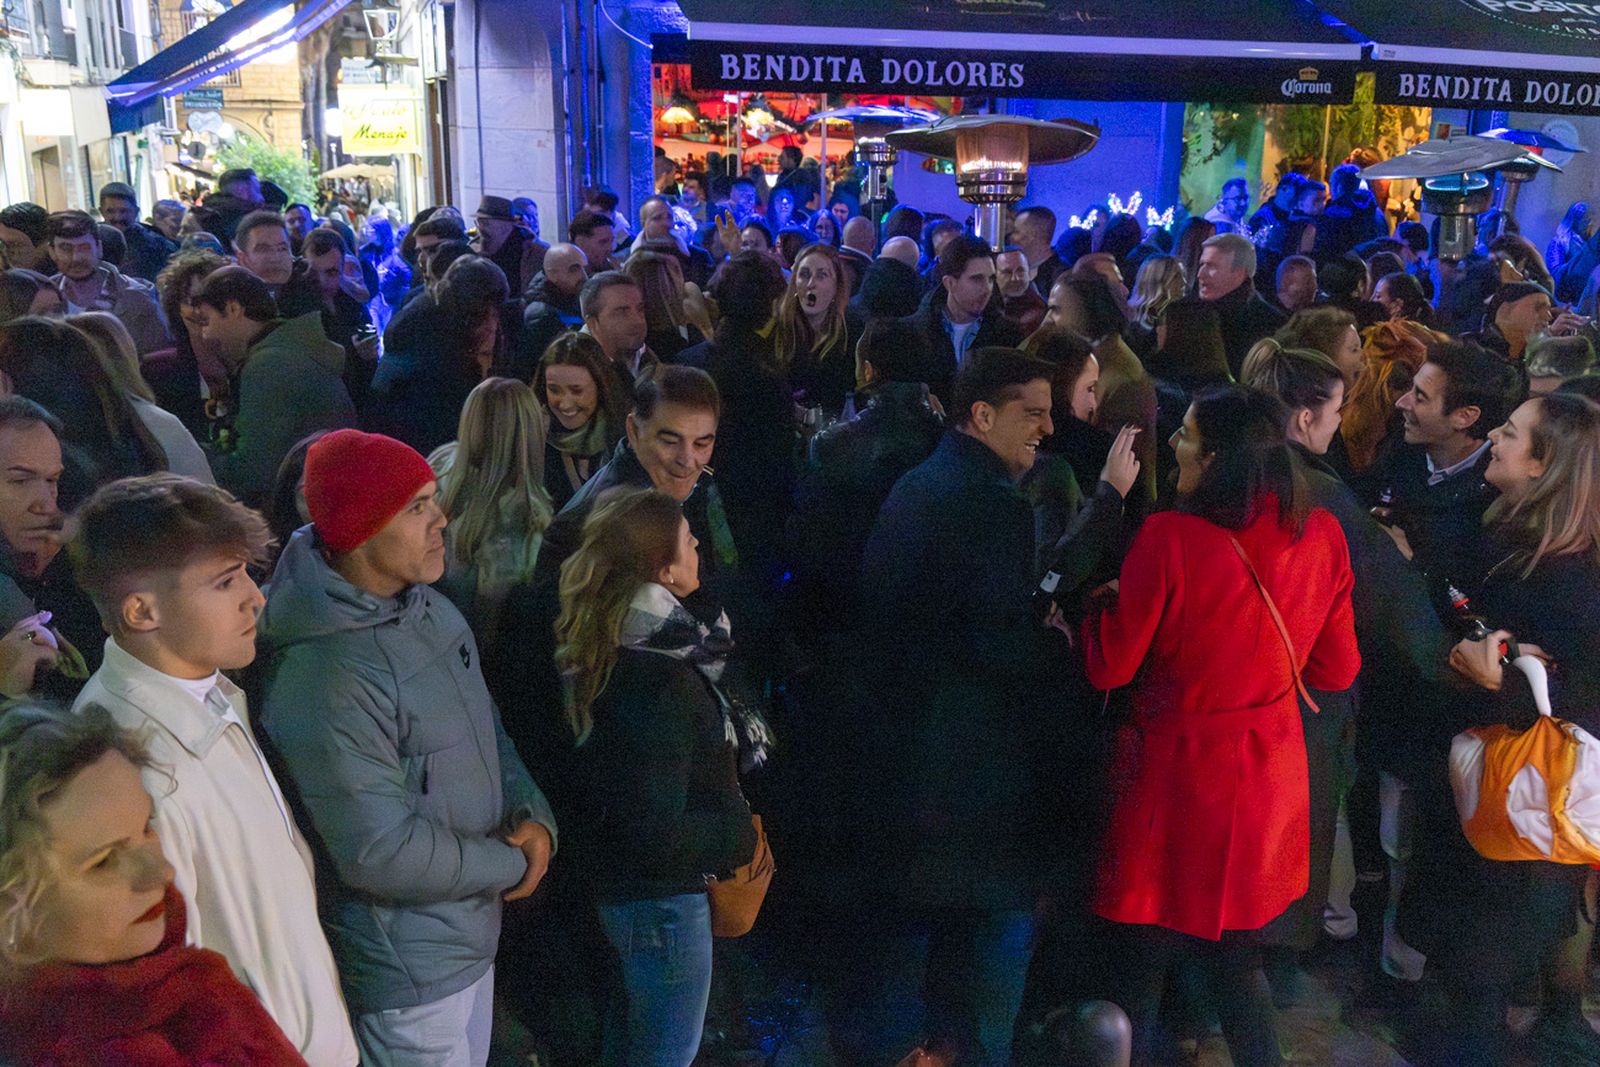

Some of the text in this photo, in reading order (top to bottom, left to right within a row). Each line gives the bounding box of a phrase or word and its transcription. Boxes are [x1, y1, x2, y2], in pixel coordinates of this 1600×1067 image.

[720, 53, 1025, 89] BENDITA DOLORES
[1280, 78, 1332, 98] Corona
[1399, 73, 1513, 103] BENDITA
[352, 124, 408, 145] Menaje
